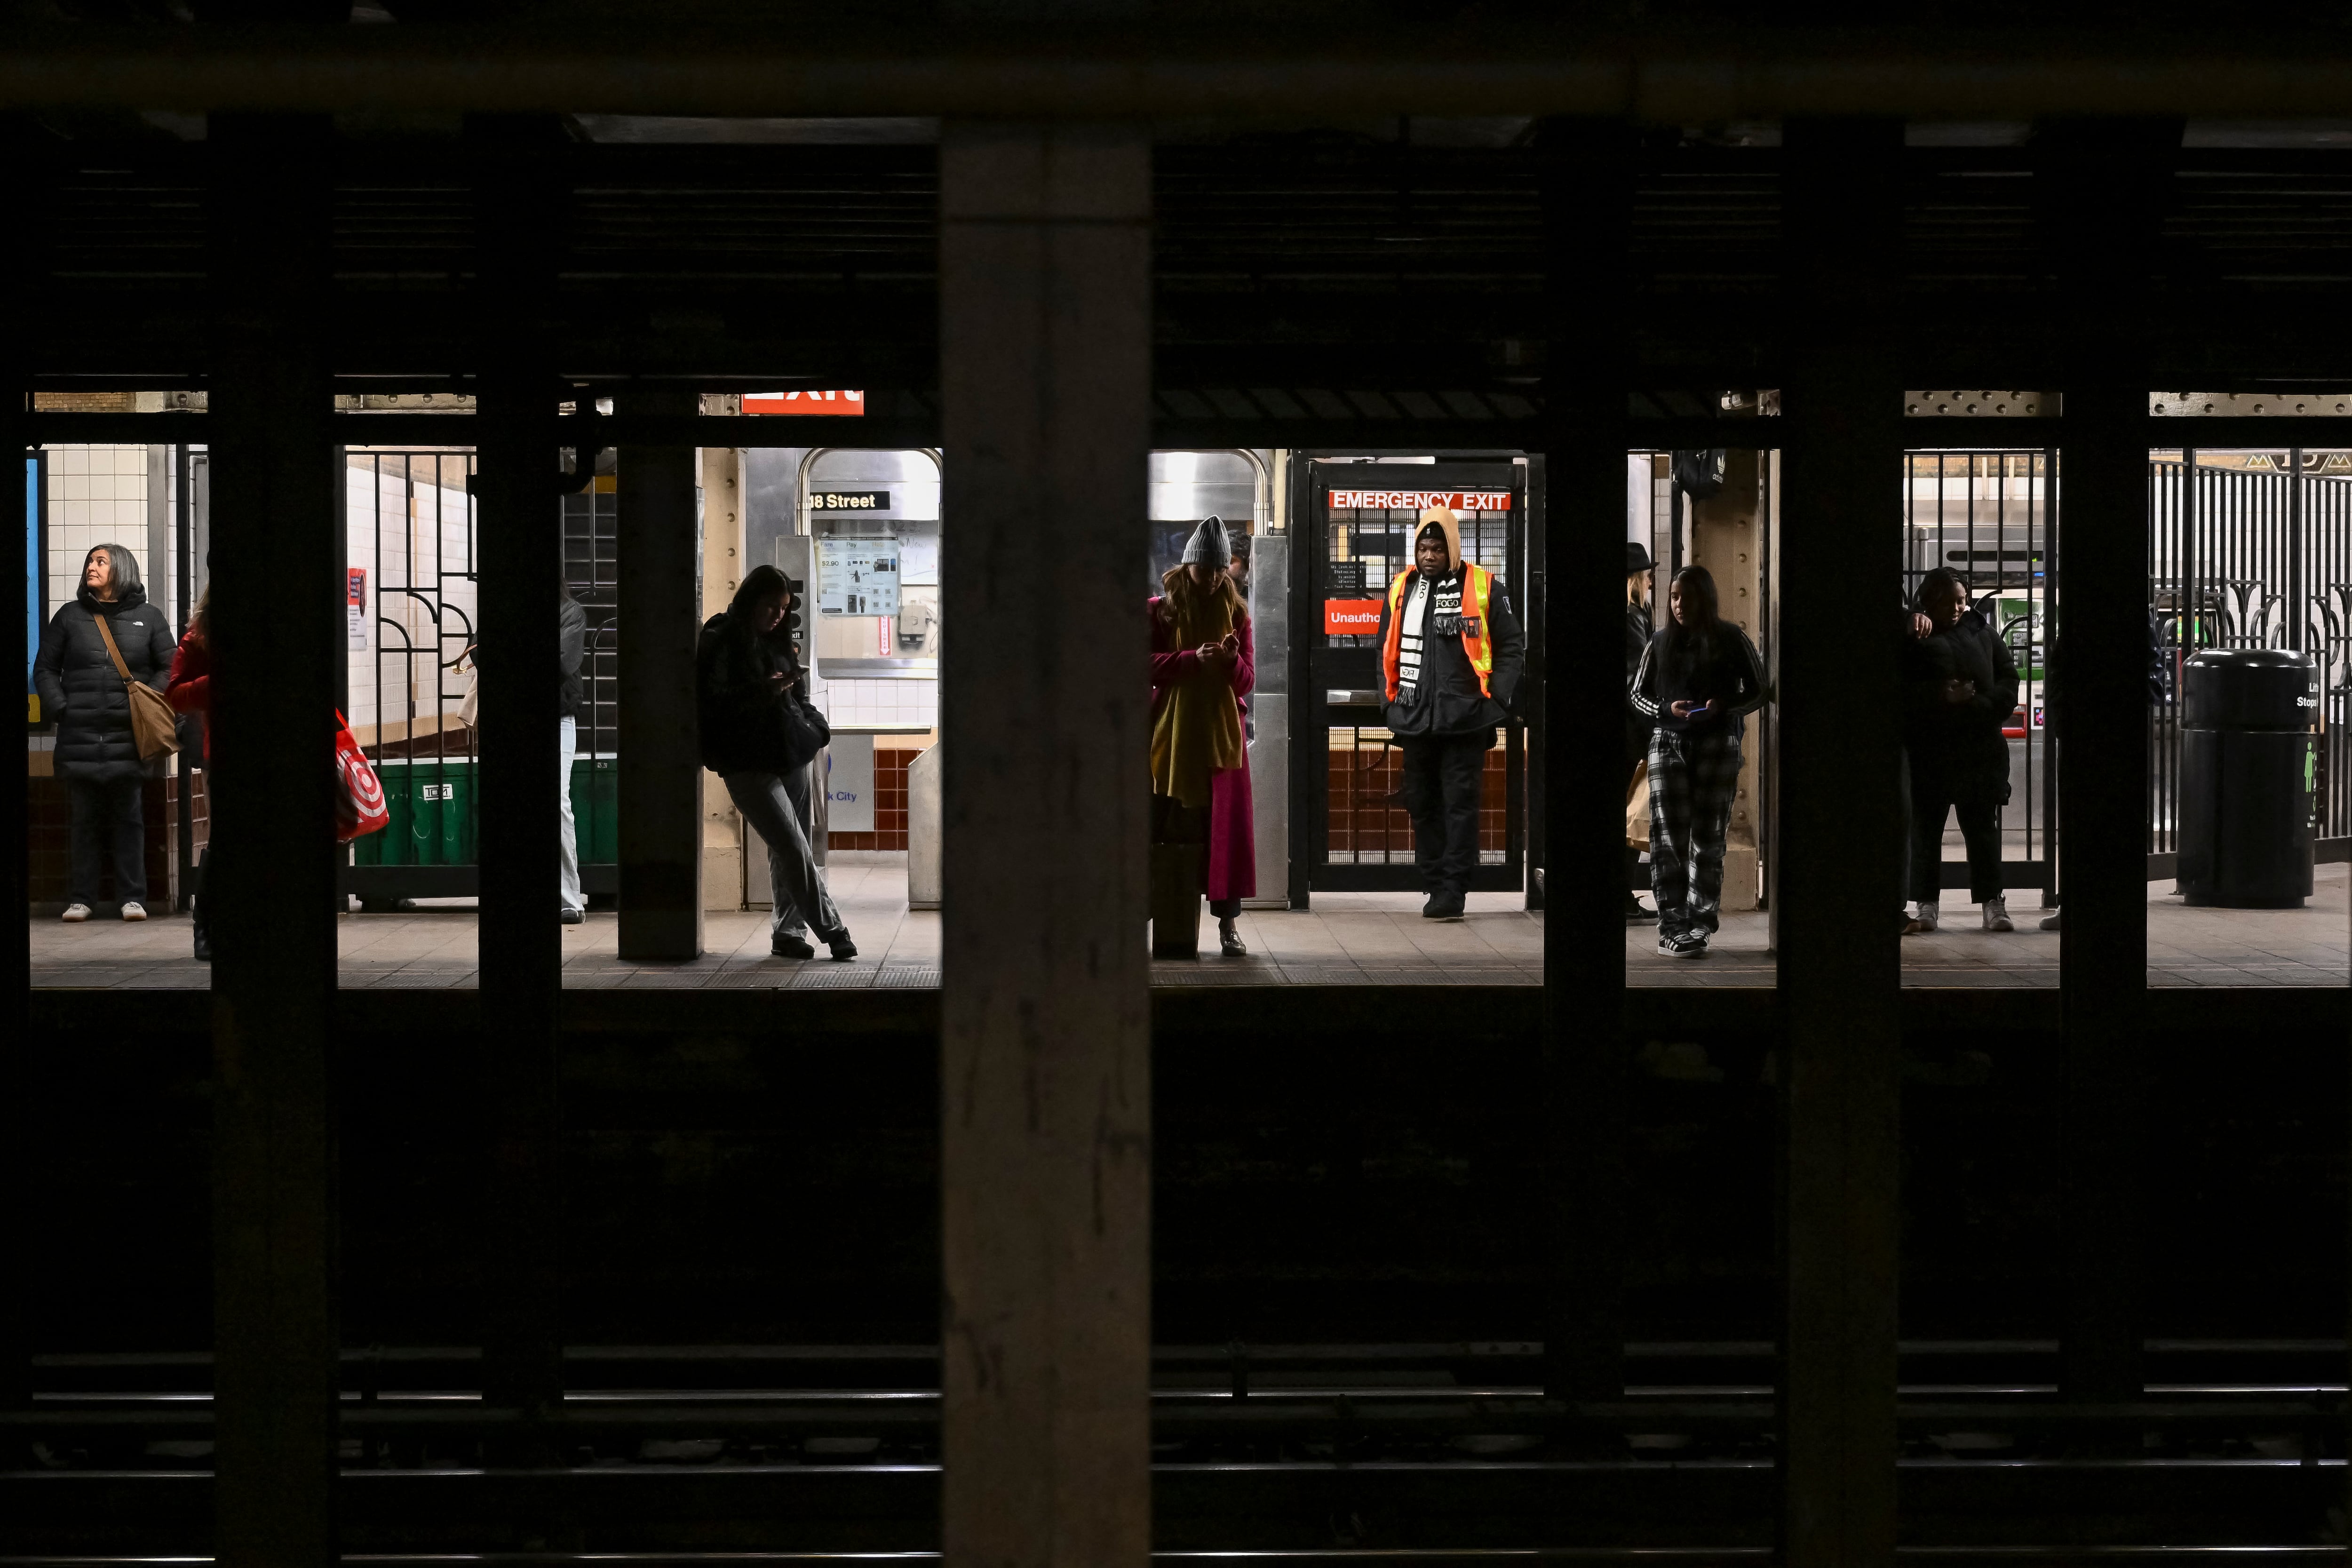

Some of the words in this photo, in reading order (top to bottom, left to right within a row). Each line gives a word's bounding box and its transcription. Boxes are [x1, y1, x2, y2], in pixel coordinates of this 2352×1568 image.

[810, 495, 823, 509] 18
[826, 494, 875, 508] Street
[1334, 492, 1454, 509] EMERGENCY
[1463, 494, 1506, 510] EXIT
[1436, 599, 1459, 608] FOGO
[2296, 696, 2317, 709] Stops
[836, 792, 857, 803] City
